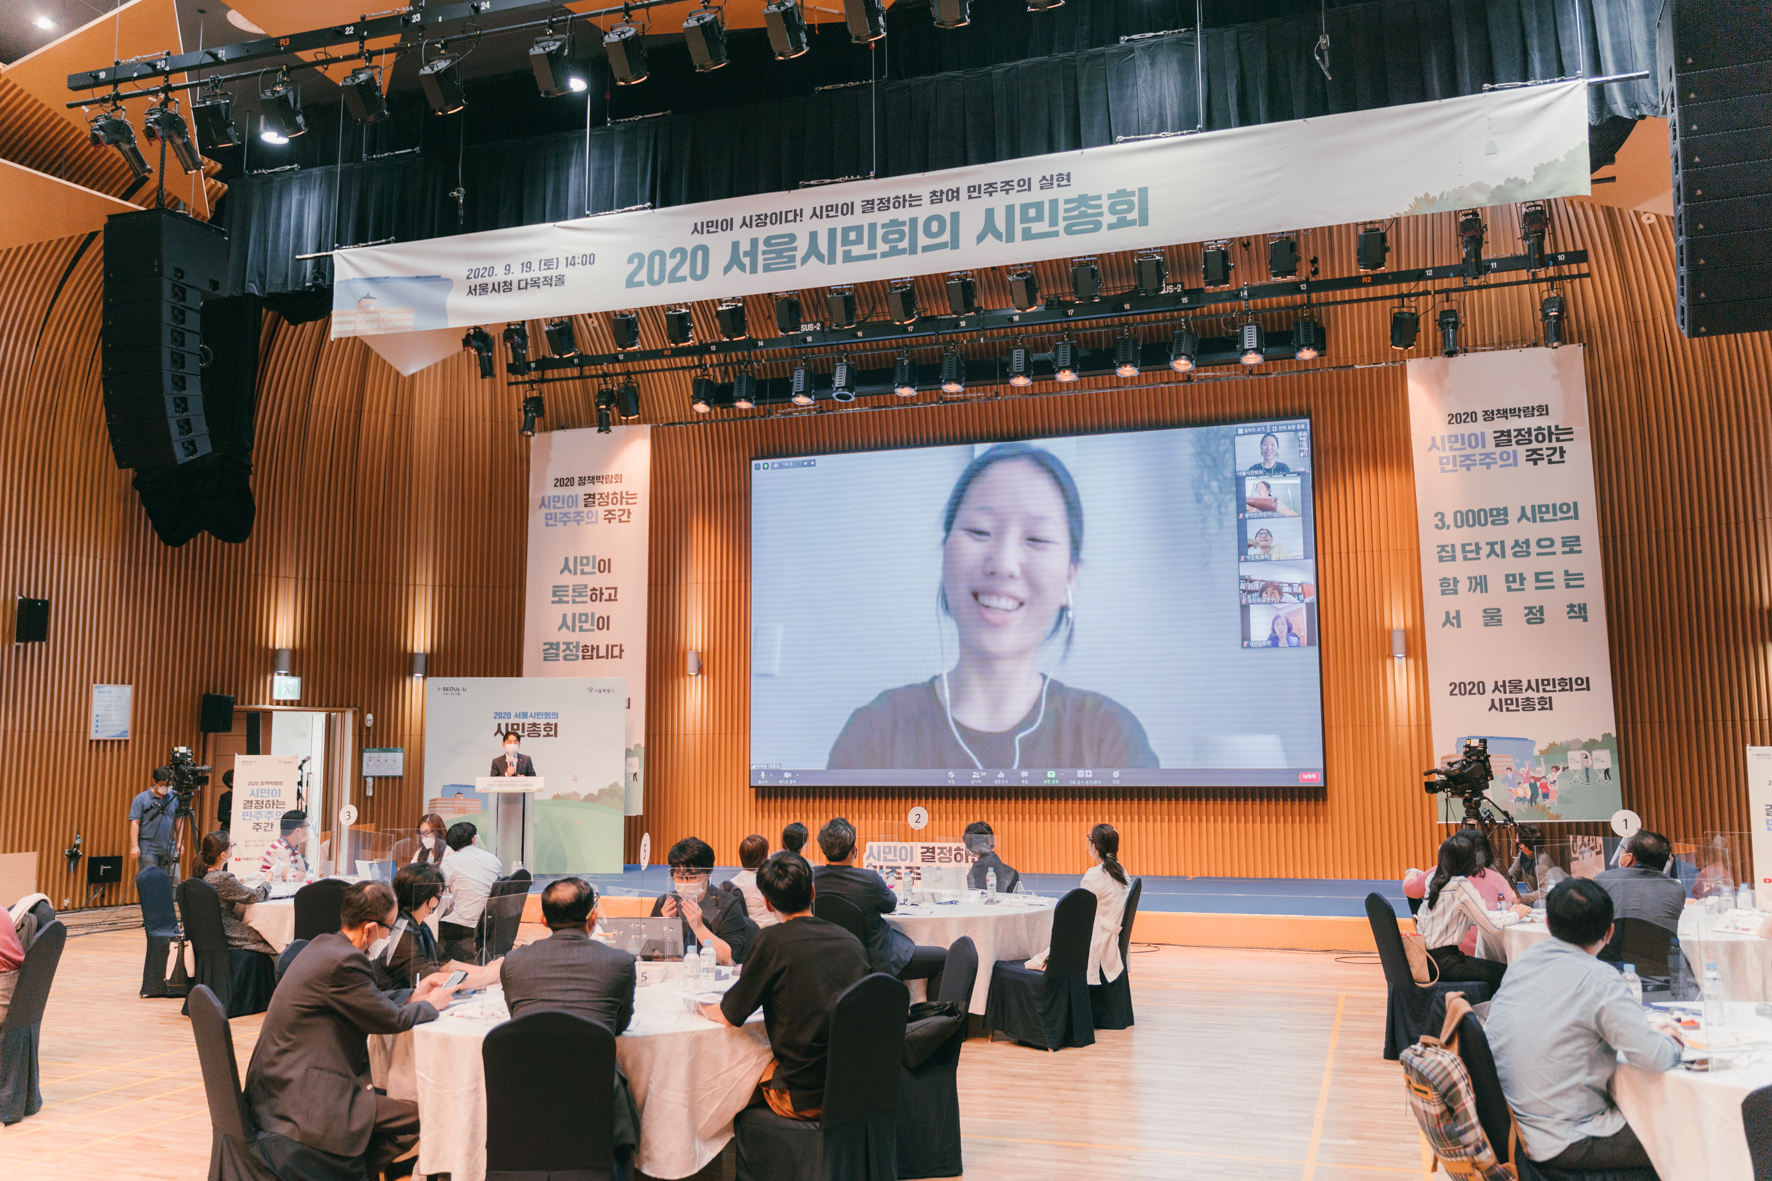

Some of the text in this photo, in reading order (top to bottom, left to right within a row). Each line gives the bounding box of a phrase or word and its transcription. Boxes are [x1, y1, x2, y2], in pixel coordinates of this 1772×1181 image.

[481, 2, 490, 10] 24
[412, 13, 421, 22] 23
[345, 26, 354, 35] 22
[280, 38, 289, 46] R3
[218, 50, 225, 58] 21
[157, 60, 165, 69] 20
[691, 171, 1072, 236] 시민이 시장이다! 시민이 결정하는 참여 민주주의 실현
[625, 186, 1150, 289] 2020 서울시민회의 시민총회
[466, 265, 498, 280] 2020.
[504, 264, 514, 276] 9.
[565, 252, 596, 268] 14:00
[466, 273, 566, 297] 서울시청 다목적홀
[1164, 284, 1182, 294] US-2
[801, 323, 821, 332] SUS-2
[1447, 404, 1549, 425] 2020 정책박람회
[1428, 424, 1574, 453] 시민이 결정하는
[1438, 446, 1566, 474] 민주주의 주간
[554, 474, 623, 487] 2020 정책박람회
[539, 491, 637, 510] 시민이 결정하는
[544, 509, 632, 527] 민주주의 주간
[1434, 501, 1579, 530] 3,000명 시민의
[1436, 535, 1582, 563] 집단지성으로
[559, 555, 611, 576] 시민이
[1439, 570, 1585, 596] 함께 만드는
[551, 584, 618, 605] 토론하고
[557, 612, 610, 633] 시민이
[542, 641, 624, 662] 결정합니다
[1449, 676, 1591, 696] 2020 서울시민회의
[1488, 696, 1553, 713] 시민총회
[494, 711, 558, 719] 2020 서울시민회의
[494, 722, 558, 738] 시민총회
[249, 788, 281, 798] 시민이
[243, 799, 286, 809] 결정하는
[345, 811, 351, 820] 3
[915, 813, 921, 823] 2
[1622, 818, 1628, 829] 1
[252, 822, 274, 832] 주간
[866, 845, 978, 863] 시민이 결정하
[641, 972, 648, 982] 5
